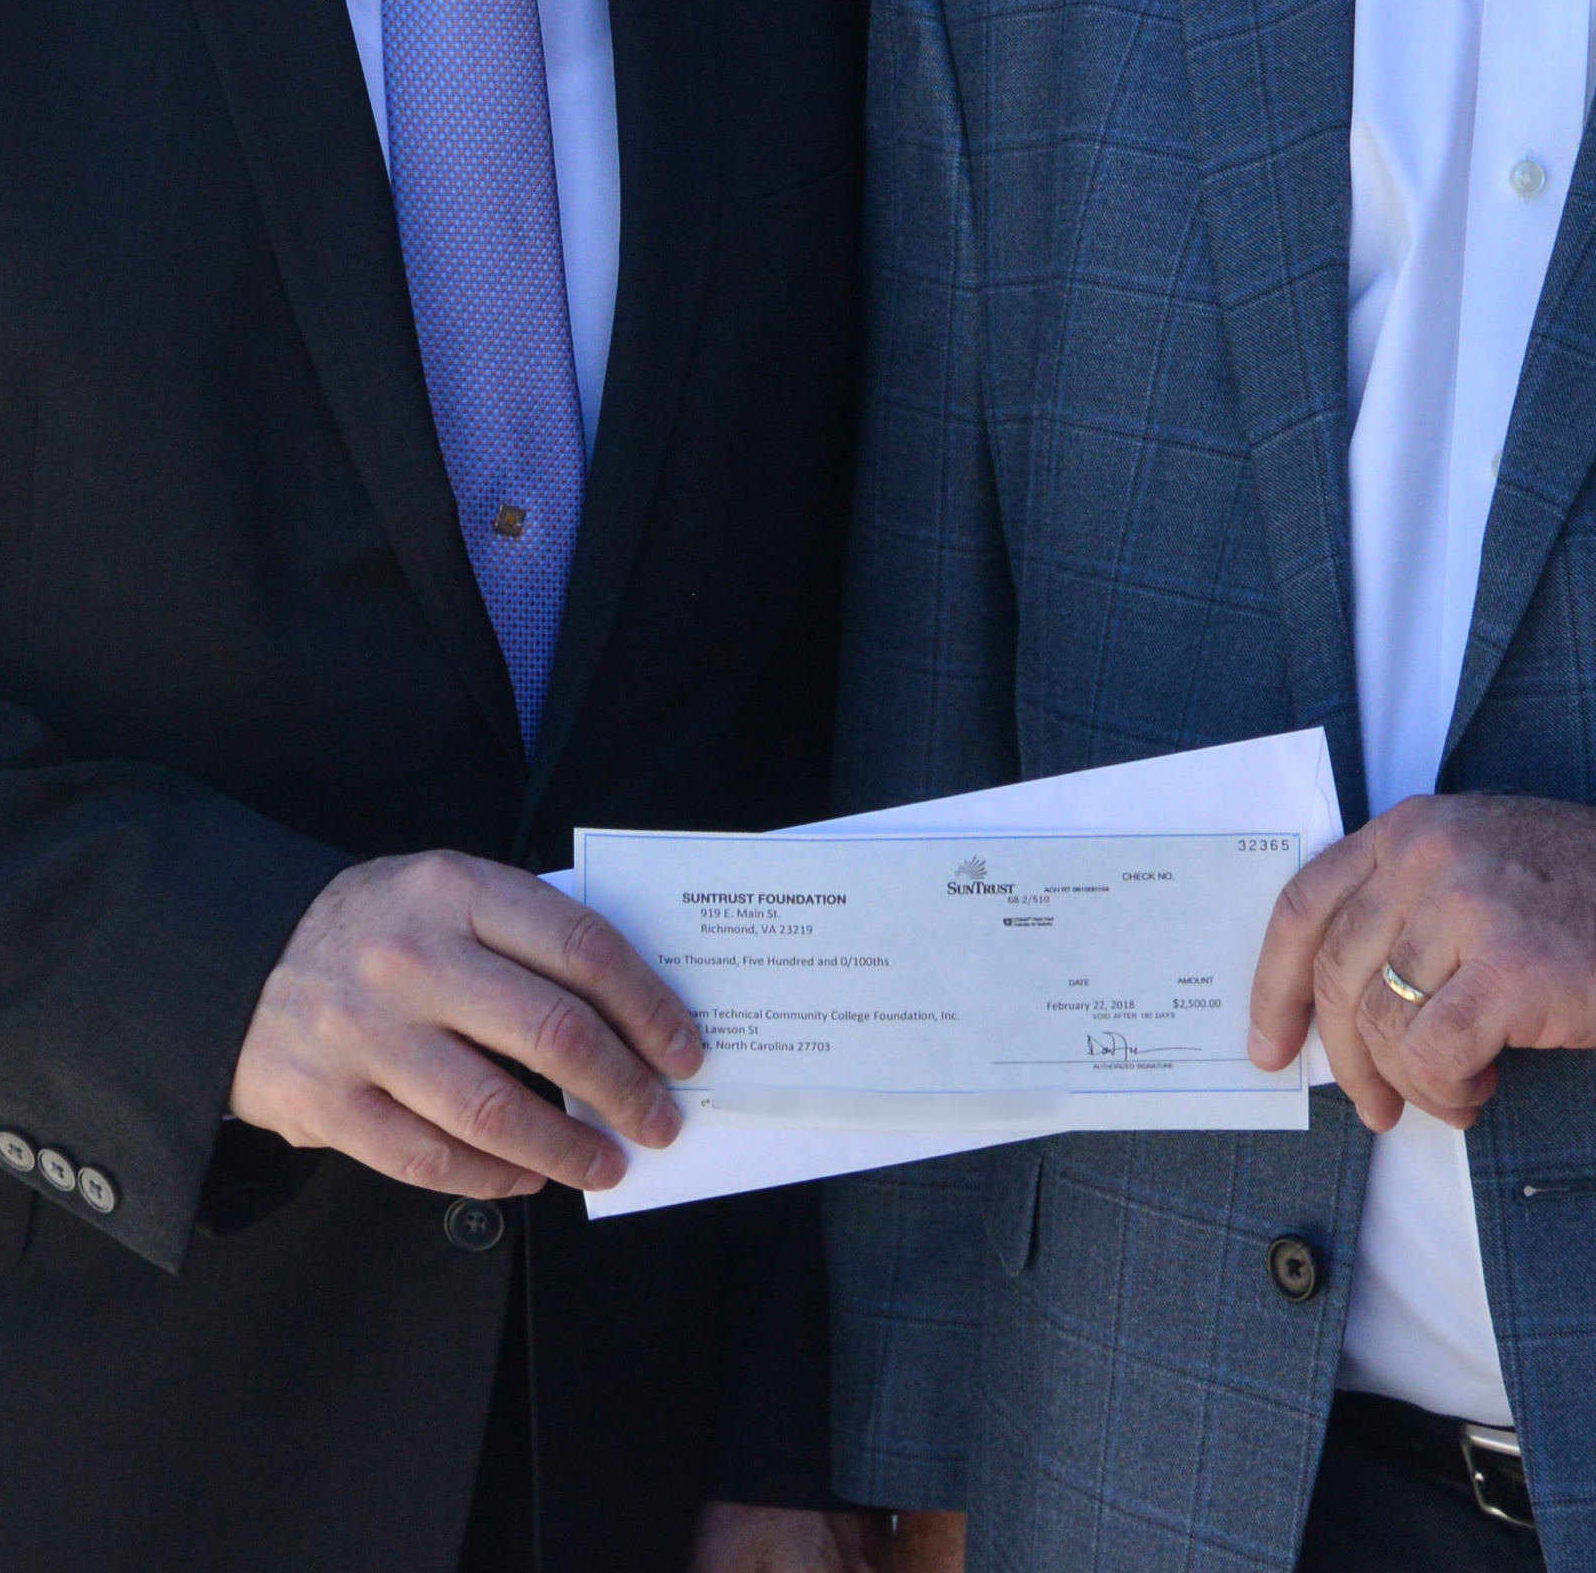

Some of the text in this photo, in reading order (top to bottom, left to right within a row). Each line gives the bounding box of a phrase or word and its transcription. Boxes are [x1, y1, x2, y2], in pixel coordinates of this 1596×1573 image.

[1238, 839, 1290, 851] 32365
[1122, 872, 1175, 881] CHECK NO.
[682, 893, 847, 905] SUNTRUST FOUNDATION
[701, 908, 781, 919] 919 E. Main St.
[701, 924, 813, 936] Richmond, VA 23219
[658, 955, 890, 968] Two Thousand, Five Hundred and 0/100ths
[1068, 979, 1089, 987] DATE
[1177, 977, 1214, 985] AMOUNT
[1046, 1000, 1135, 1012] February 22, 2018
[1172, 998, 1222, 1009] $2,500.00
[713, 1009, 763, 1020] Technical
[765, 1010, 828, 1023] Community
[831, 1010, 870, 1023] College
[873, 1010, 938, 1022] Foundation,
[941, 1011, 960, 1021] Inc.
[705, 1025, 745, 1035] Lawson
[748, 1025, 759, 1035] St
[716, 1040, 747, 1050] North
[750, 1041, 794, 1051] Carolina
[797, 1041, 831, 1052] 27703
